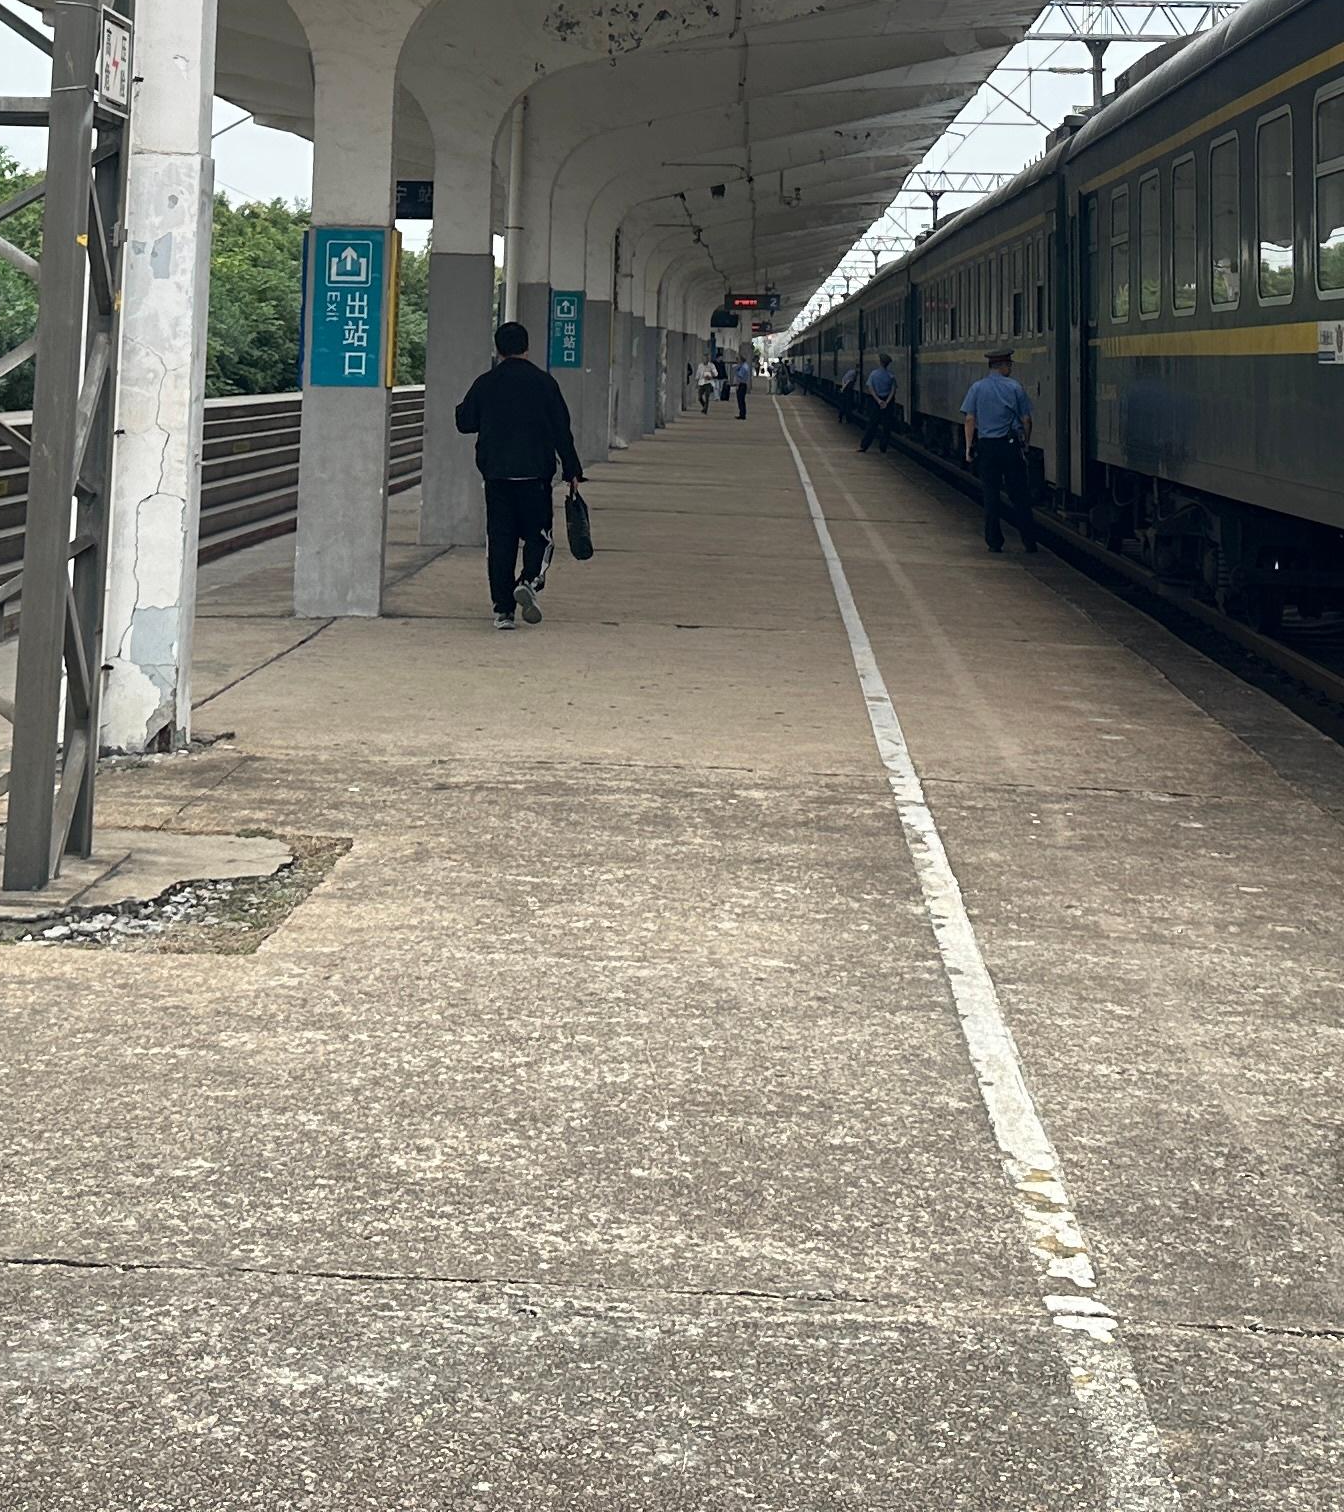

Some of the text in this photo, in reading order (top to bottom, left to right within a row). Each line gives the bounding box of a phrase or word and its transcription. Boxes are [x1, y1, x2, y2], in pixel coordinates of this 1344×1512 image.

[325, 291, 341, 322] Exit
[342, 291, 370, 376] 出站口
[563, 321, 576, 362] 出站口
